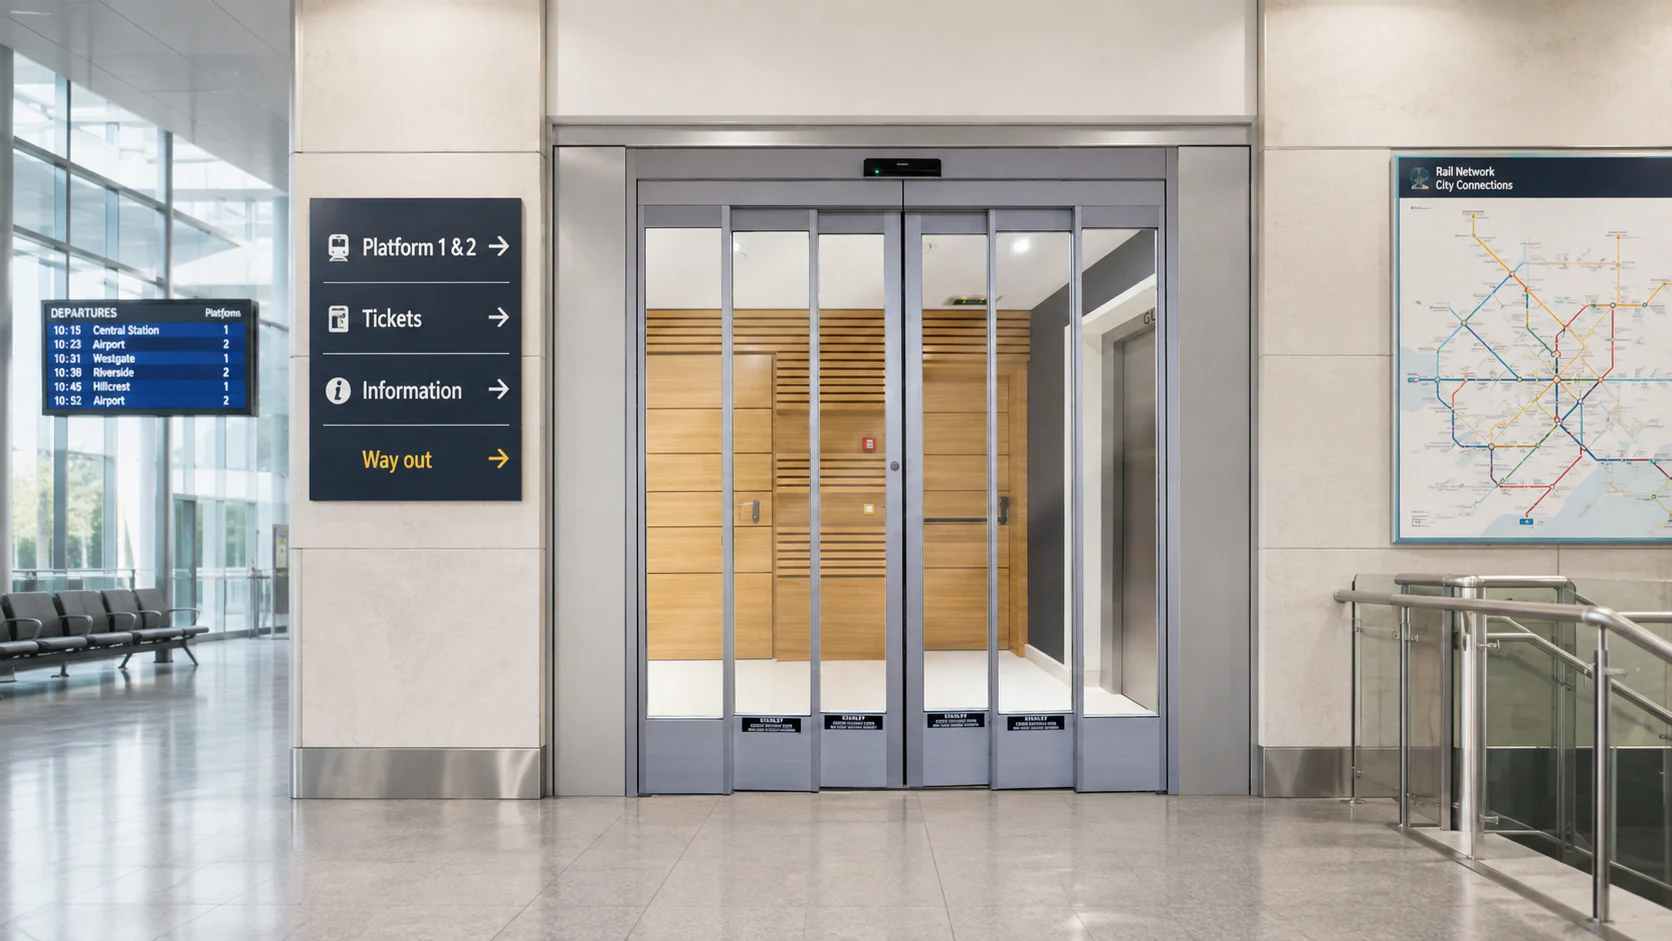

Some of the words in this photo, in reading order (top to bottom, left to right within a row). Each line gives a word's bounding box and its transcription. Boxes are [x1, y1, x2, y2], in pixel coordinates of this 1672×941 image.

[1436, 166, 1454, 177] Rail
[1456, 166, 1495, 177] Network
[1436, 180, 1455, 192] City
[1457, 179, 1514, 191] Connections
[363, 237, 434, 257] Platform
[439, 237, 446, 257] 1
[450, 237, 464, 257] &
[466, 237, 477, 257] 2
[51, 308, 117, 318] DEPARTURES
[362, 308, 422, 328] Tickets
[54, 325, 81, 335] 10:15
[93, 325, 125, 335] Central
[128, 325, 159, 335] Station
[223, 325, 229, 334] 1
[54, 339, 81, 349] 10:23
[93, 340, 125, 351] Airport
[223, 339, 230, 349] 2
[54, 354, 80, 363] 10:31
[93, 354, 135, 365] Westgate
[223, 354, 229, 363] 1
[94, 367, 134, 377] Riverside
[223, 367, 230, 377] 2
[54, 382, 82, 391] 10:45
[93, 381, 130, 391] Hillcrest
[223, 382, 229, 391] 1
[363, 380, 462, 400] Information
[93, 396, 125, 407] Airport
[223, 396, 230, 405] 2
[362, 450, 399, 473] Way
[403, 452, 433, 469] out
